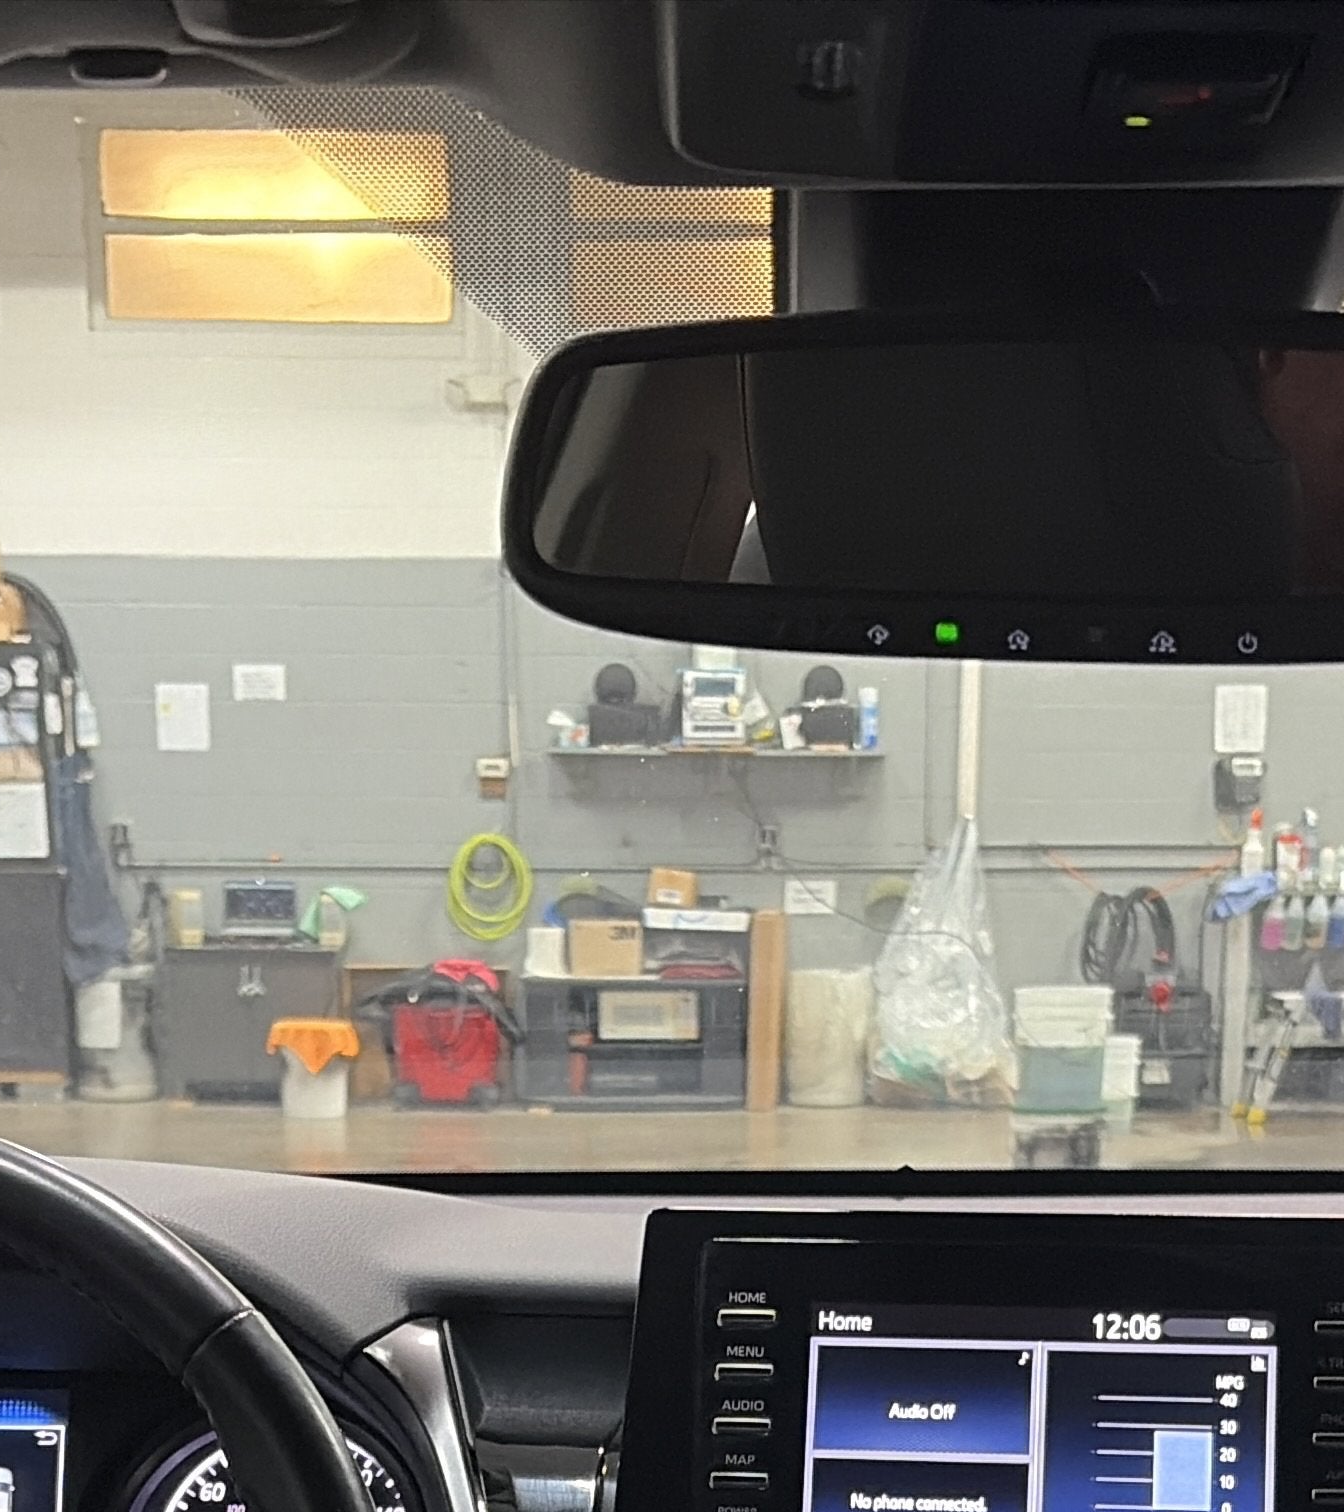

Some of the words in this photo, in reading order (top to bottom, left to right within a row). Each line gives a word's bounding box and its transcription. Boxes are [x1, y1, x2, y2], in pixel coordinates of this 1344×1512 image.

[609, 926, 637, 941] 3M
[728, 1292, 767, 1304] HOME
[818, 1310, 873, 1331] Home
[1092, 1313, 1162, 1340] 12:06
[726, 1346, 765, 1357] MENU
[1215, 1375, 1245, 1390] MPG
[721, 1400, 765, 1411] AUDIO
[1219, 1393, 1238, 1408] 40
[888, 1403, 929, 1419] Audio
[930, 1403, 957, 1420] Off
[1219, 1419, 1237, 1435] 30
[725, 1454, 756, 1465] MAP
[1219, 1447, 1237, 1462] 20
[1219, 1474, 1235, 1490] 10
[200, 1482, 226, 1502] 60
[850, 1493, 872, 1509] No
[873, 1494, 915, 1512] phone
[916, 1496, 988, 1512] connected.
